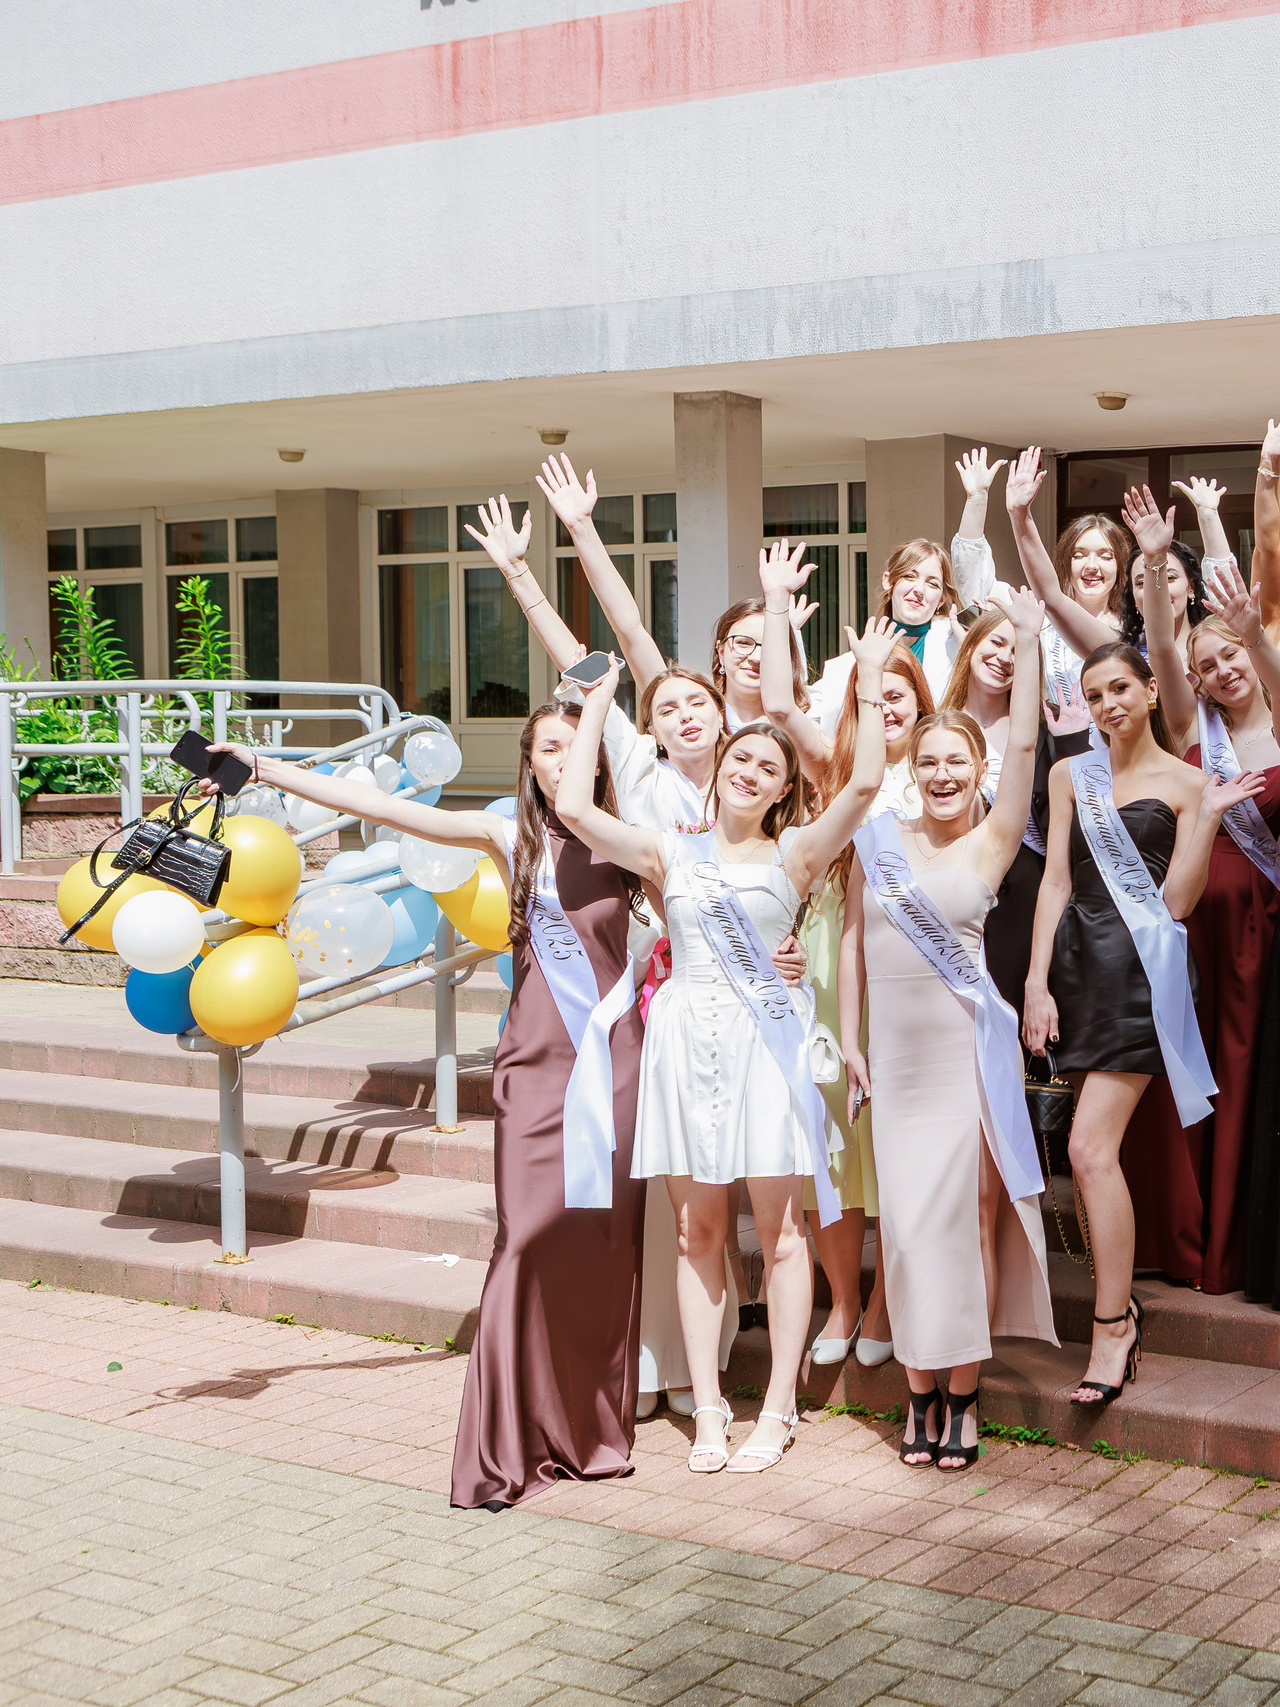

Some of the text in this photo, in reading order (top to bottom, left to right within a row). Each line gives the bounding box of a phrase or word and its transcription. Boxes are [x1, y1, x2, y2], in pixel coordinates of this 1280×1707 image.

[1077, 764, 1123, 860] Выпускница
[1111, 856, 1159, 904] 2025
[536, 911, 584, 960] 2025
[691, 861, 796, 1021] Выпускница 2025
[874, 850, 945, 945] Выпускница
